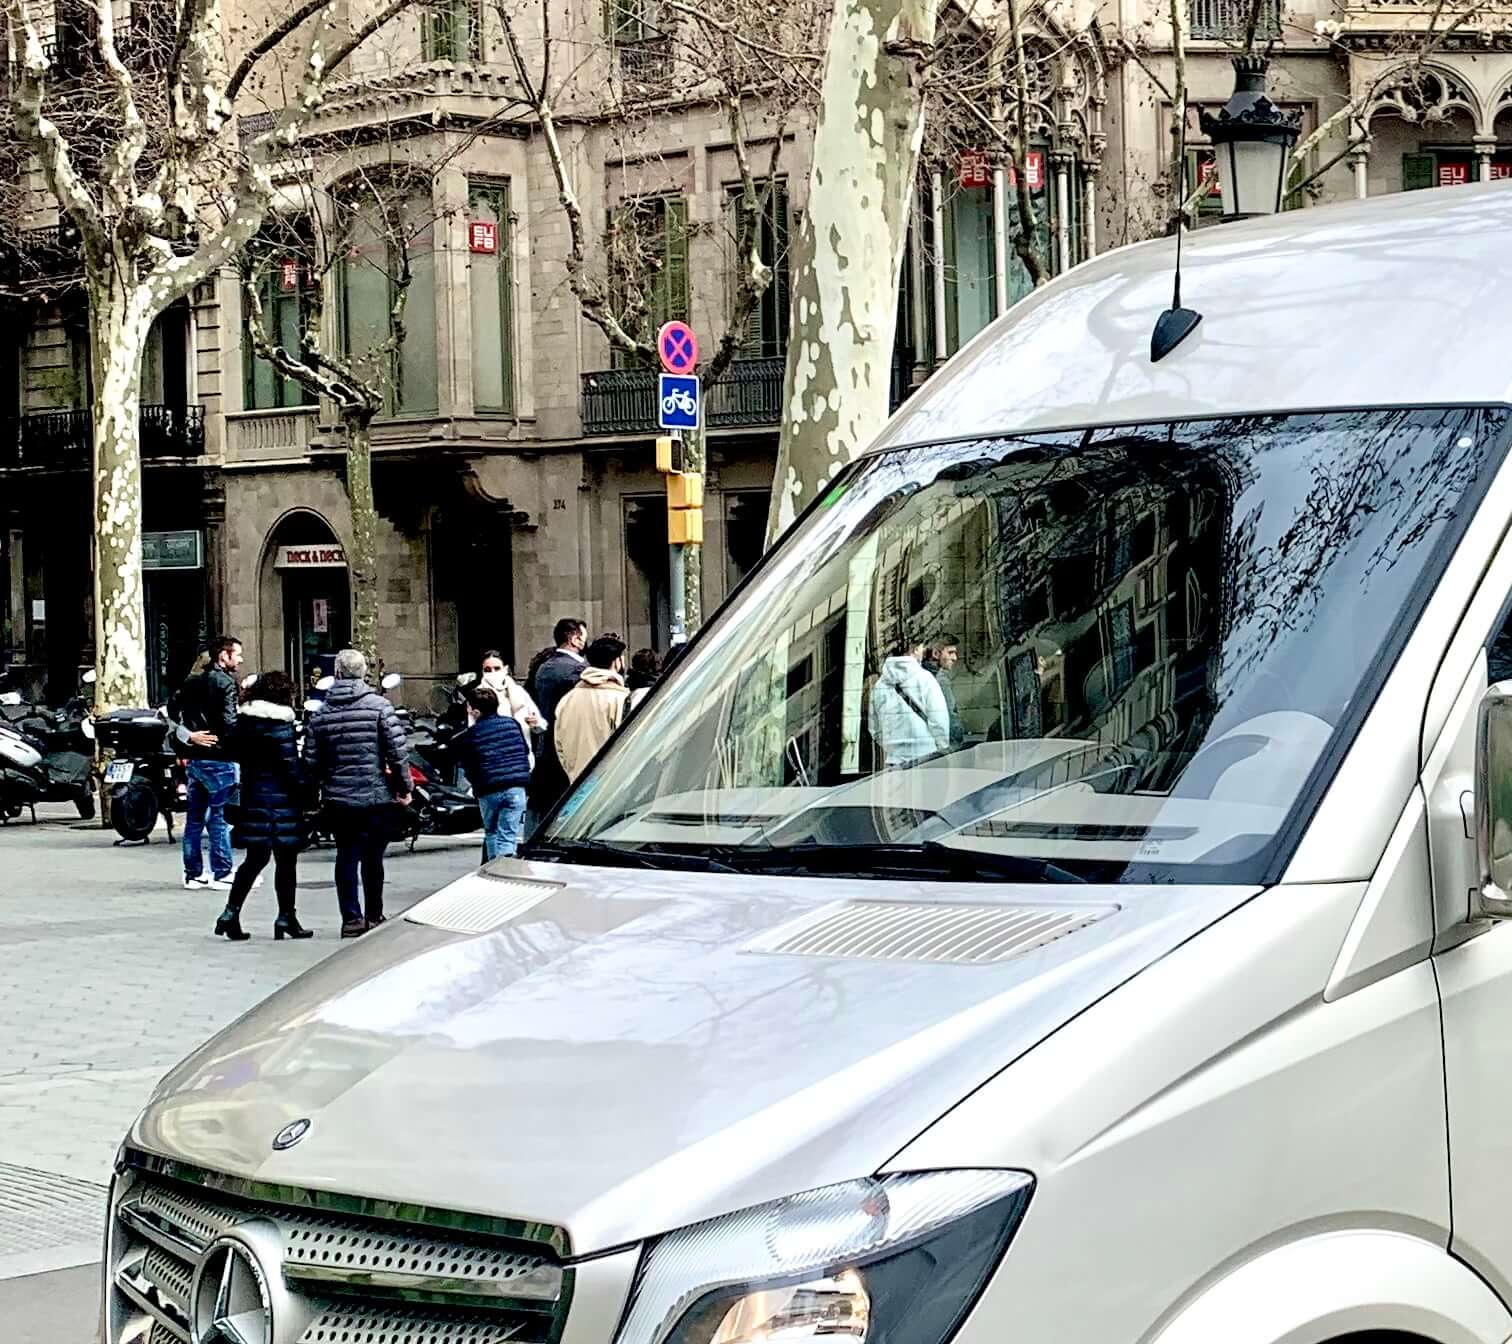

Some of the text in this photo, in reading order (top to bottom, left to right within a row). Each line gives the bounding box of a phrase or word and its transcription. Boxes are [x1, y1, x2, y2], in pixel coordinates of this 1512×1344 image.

[1440, 167, 1465, 179] EU
[474, 225, 493, 237] EU
[474, 238, 493, 249] FB
